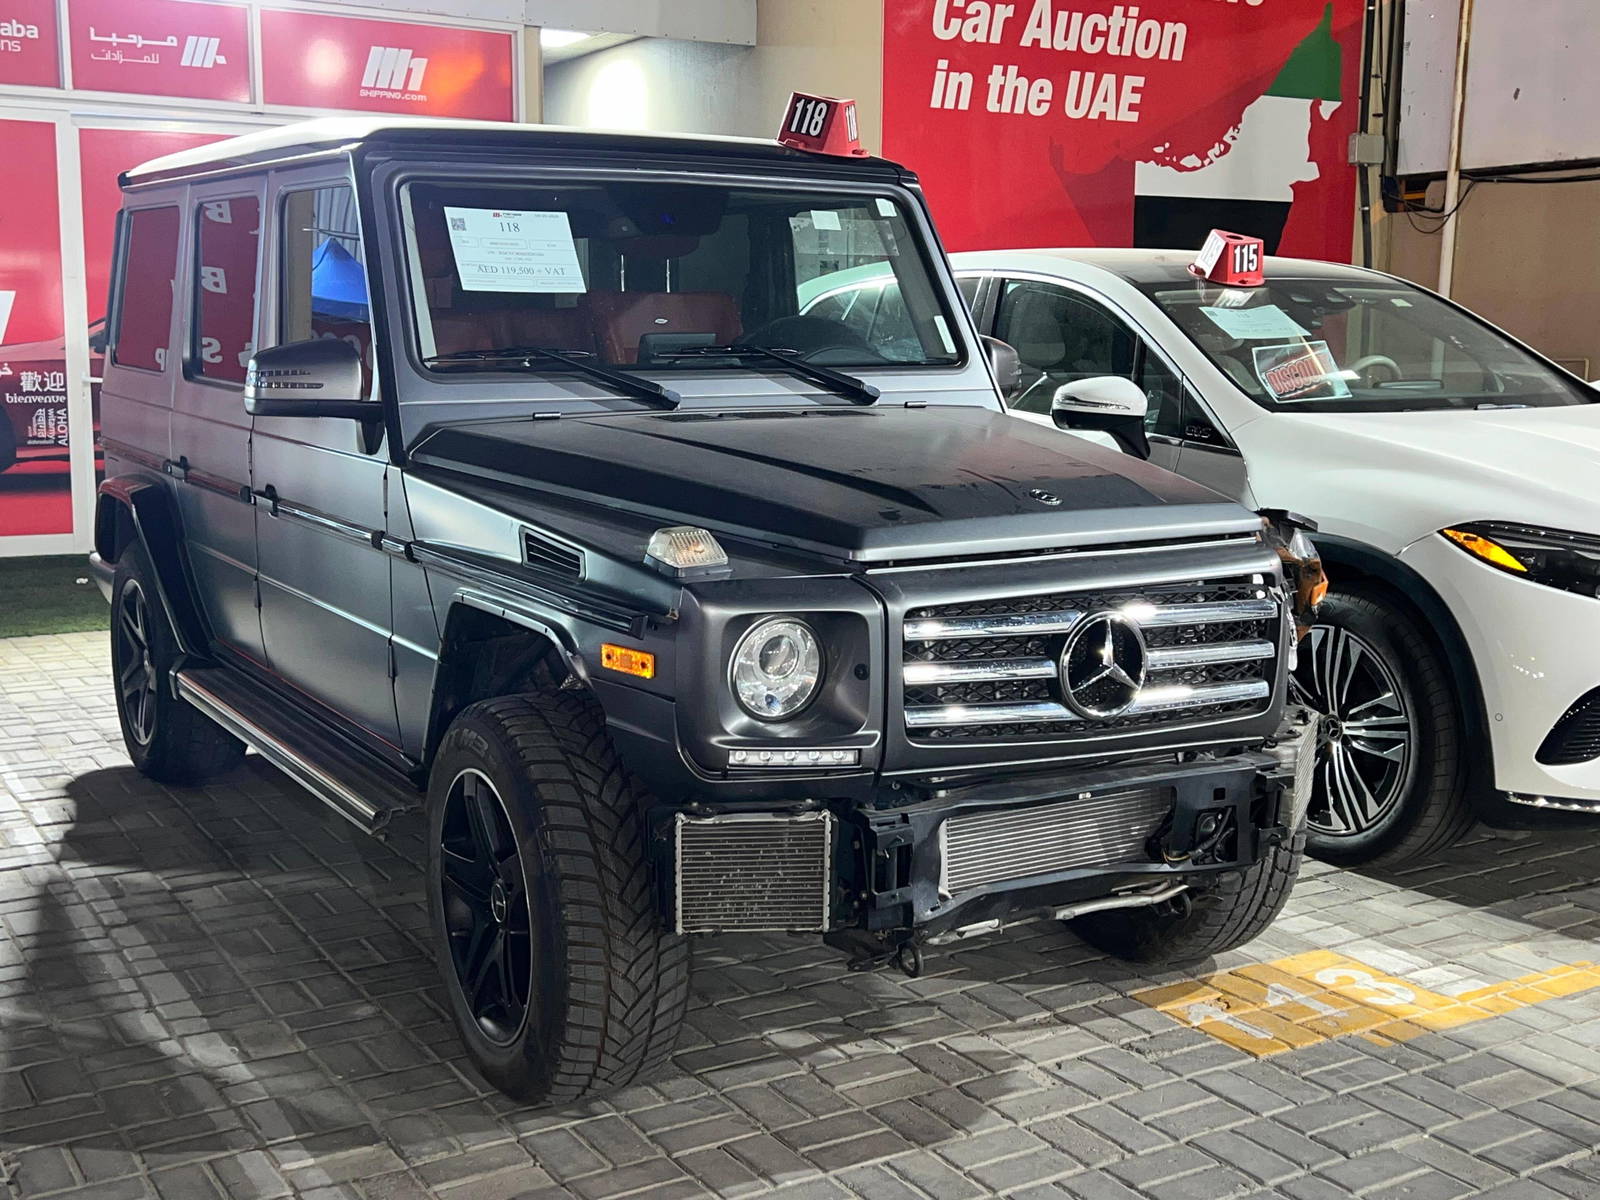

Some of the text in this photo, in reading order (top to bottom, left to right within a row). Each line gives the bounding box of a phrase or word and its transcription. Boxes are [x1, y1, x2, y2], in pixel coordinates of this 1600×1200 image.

[932, 0, 1187, 61] Car Auction
[930, 59, 1146, 122] in the UAE
[790, 99, 828, 137] 118
[500, 222, 520, 232] 118
[477, 265, 498, 274] AED
[501, 266, 535, 275] 119,500
[544, 267, 566, 276] VAT
[1234, 244, 1258, 273] 115
[20, 371, 66, 392] 歡迎
[1265, 354, 1333, 394] DISCOU
[6, 393, 66, 403] bienvenue
[57, 408, 68, 446] ALOHA
